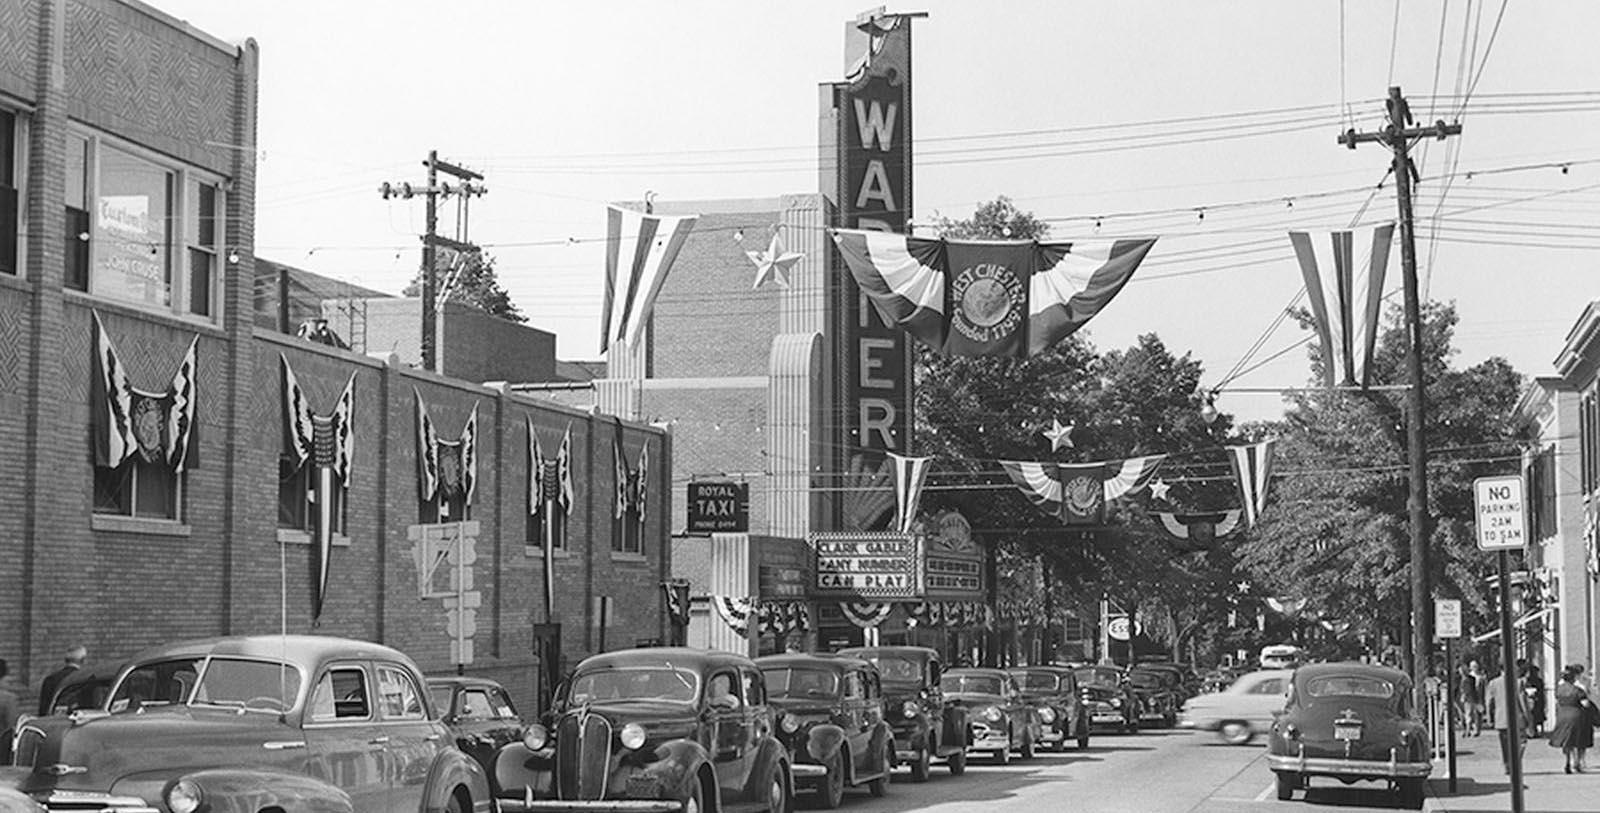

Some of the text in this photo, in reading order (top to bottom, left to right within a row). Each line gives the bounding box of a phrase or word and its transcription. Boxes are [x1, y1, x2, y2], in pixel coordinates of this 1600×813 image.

[854, 98, 896, 449] WANER
[975, 263, 1026, 304] CHESTER
[698, 486, 735, 497] ROYAL
[1489, 486, 1511, 500] NO
[697, 500, 735, 516] TAXI
[1481, 502, 1521, 513] PARKING
[1491, 517, 1512, 527] 2AM
[1484, 531, 1496, 540] TO
[818, 543, 907, 553] CLARK GABLE
[858, 559, 907, 570] NUMBER
[822, 575, 903, 587] CAN PLAY
